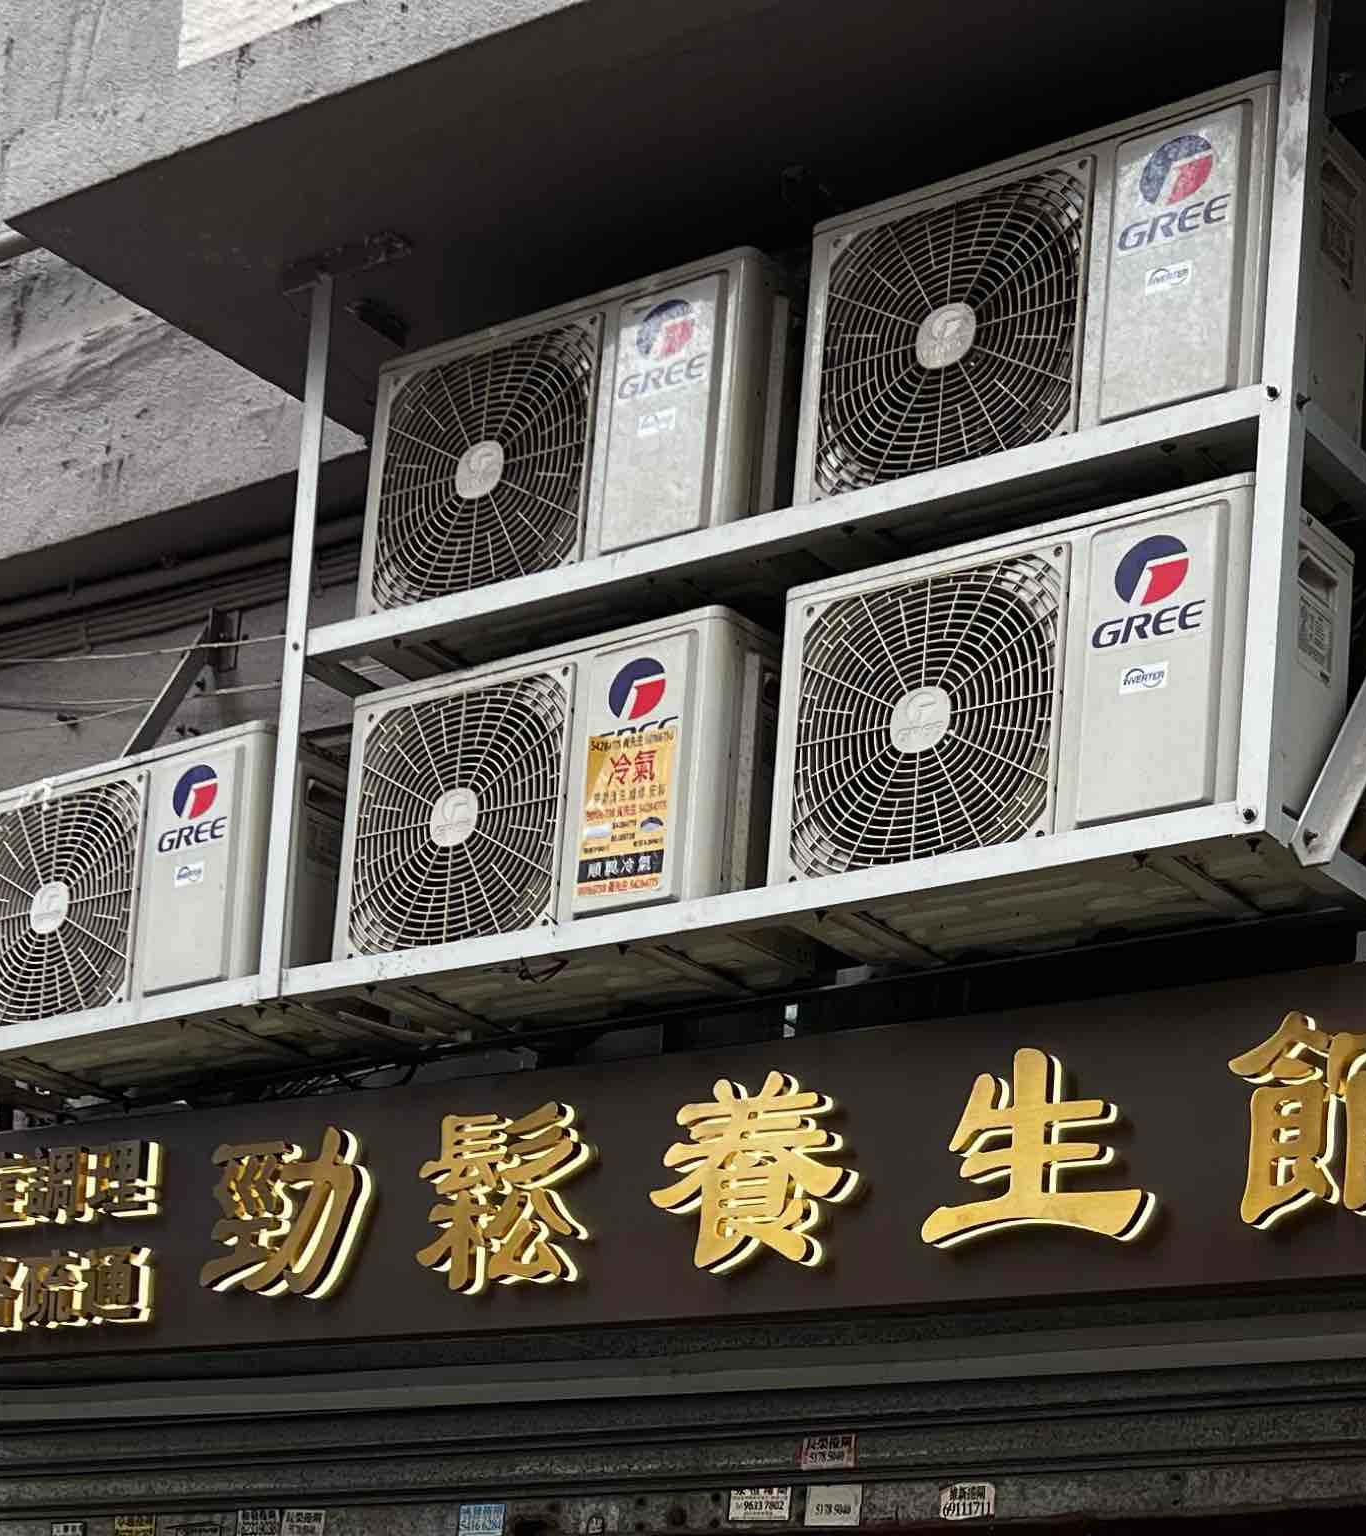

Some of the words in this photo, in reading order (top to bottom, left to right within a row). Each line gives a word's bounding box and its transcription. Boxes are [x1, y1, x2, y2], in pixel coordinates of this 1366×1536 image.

[1118, 193, 1232, 251] GREE
[618, 352, 708, 399] GREE
[1092, 599, 1206, 649] GREE
[608, 750, 657, 785] 冷氣
[158, 816, 228, 853] GREE
